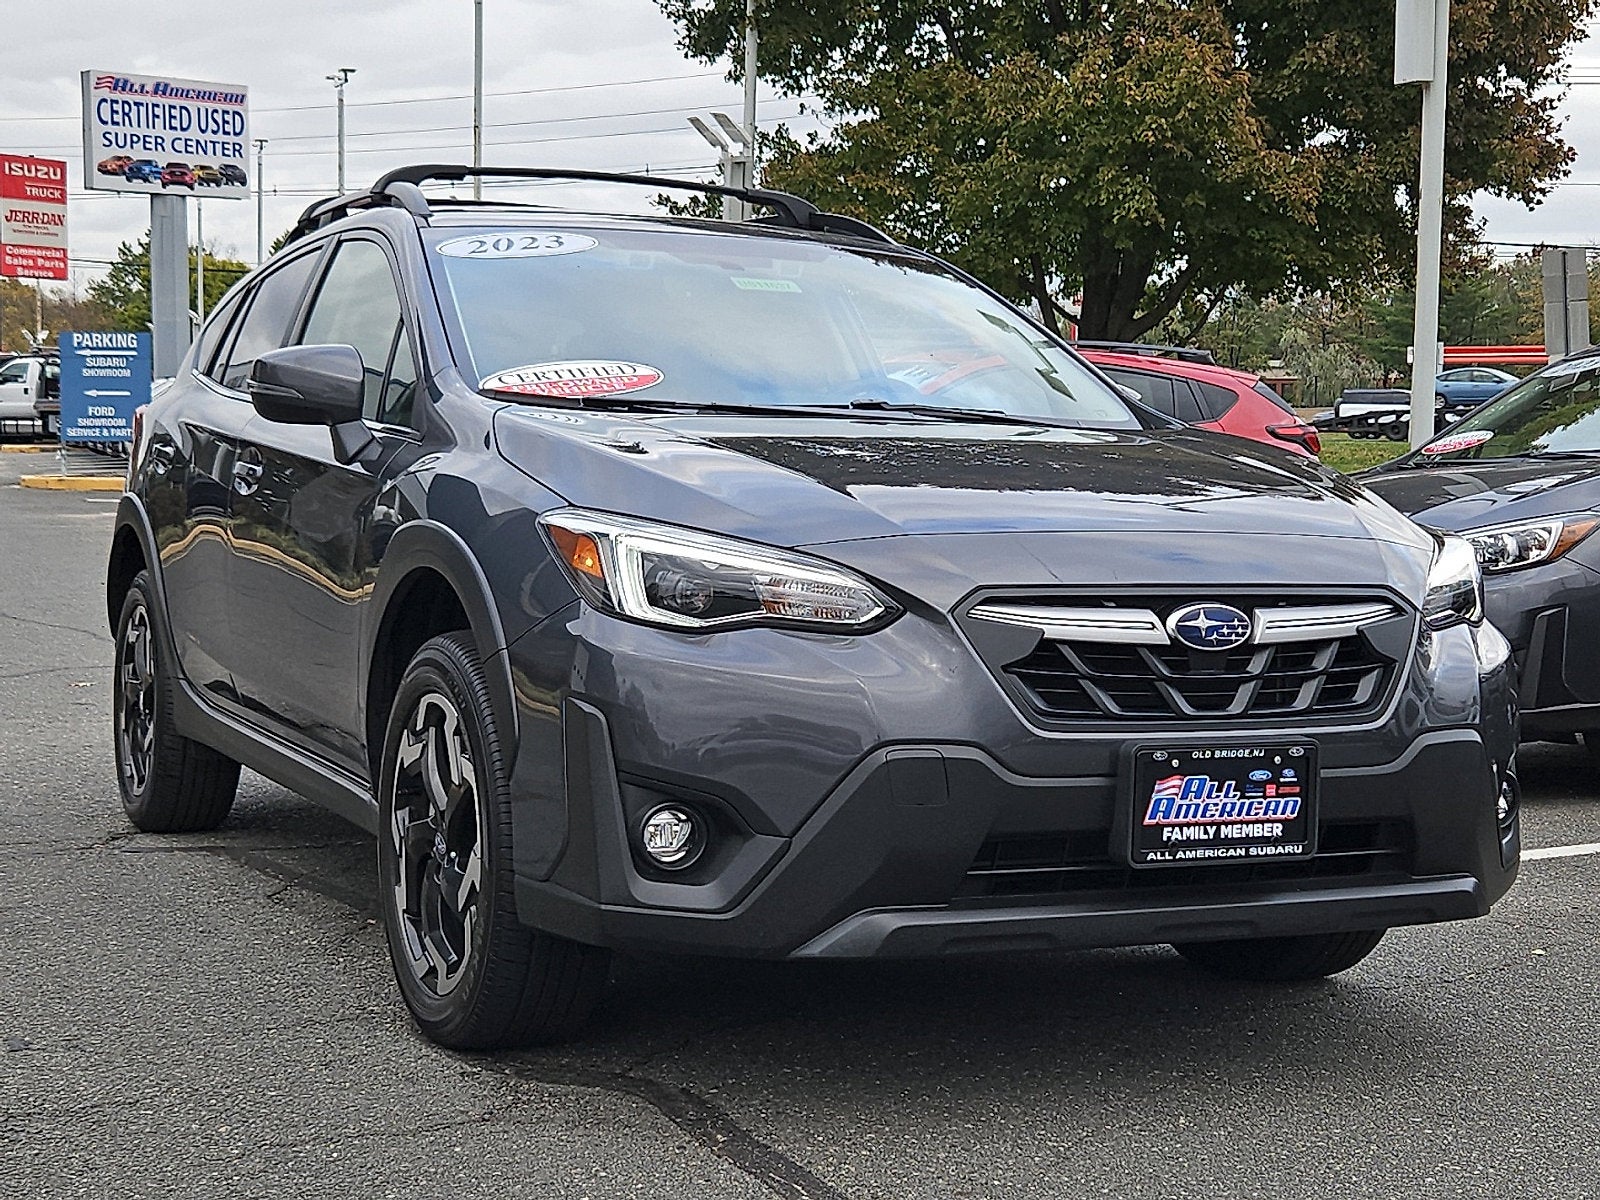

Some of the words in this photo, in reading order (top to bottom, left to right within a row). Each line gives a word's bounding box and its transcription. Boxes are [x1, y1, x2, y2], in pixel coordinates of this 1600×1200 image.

[96, 98, 192, 132] CERTIFIED
[197, 107, 245, 137] USED
[102, 131, 166, 152] SUPER
[171, 137, 244, 158] CENTER
[4, 161, 62, 180] ISUZU
[25, 186, 62, 199] TRUCK
[5, 245, 64, 258] Commercial
[468, 235, 565, 254] 2023
[5, 255, 34, 266] Sales
[37, 258, 65, 268] Parts
[16, 266, 55, 278] Service
[73, 332, 138, 348] PARKING
[86, 356, 127, 367] SUBARU
[82, 368, 132, 377] SHOWROOM
[498, 363, 637, 384] CERTIFIED
[88, 406, 115, 416] FORD
[77, 418, 127, 427] SHOWROOM
[66, 427, 101, 437] SERVICE
[102, 427, 109, 437] &
[110, 428, 133, 437] PART
[1191, 750, 1212, 759] OLD
[1179, 775, 1241, 801] ALL
[1145, 796, 1302, 824] AMERICAN
[1162, 826, 1218, 842] FAMILY
[1220, 823, 1284, 839] MEMBER
[1146, 851, 1174, 861] ALL
[1175, 848, 1246, 859] AMERICAN
[1249, 845, 1303, 856] SUBARU
